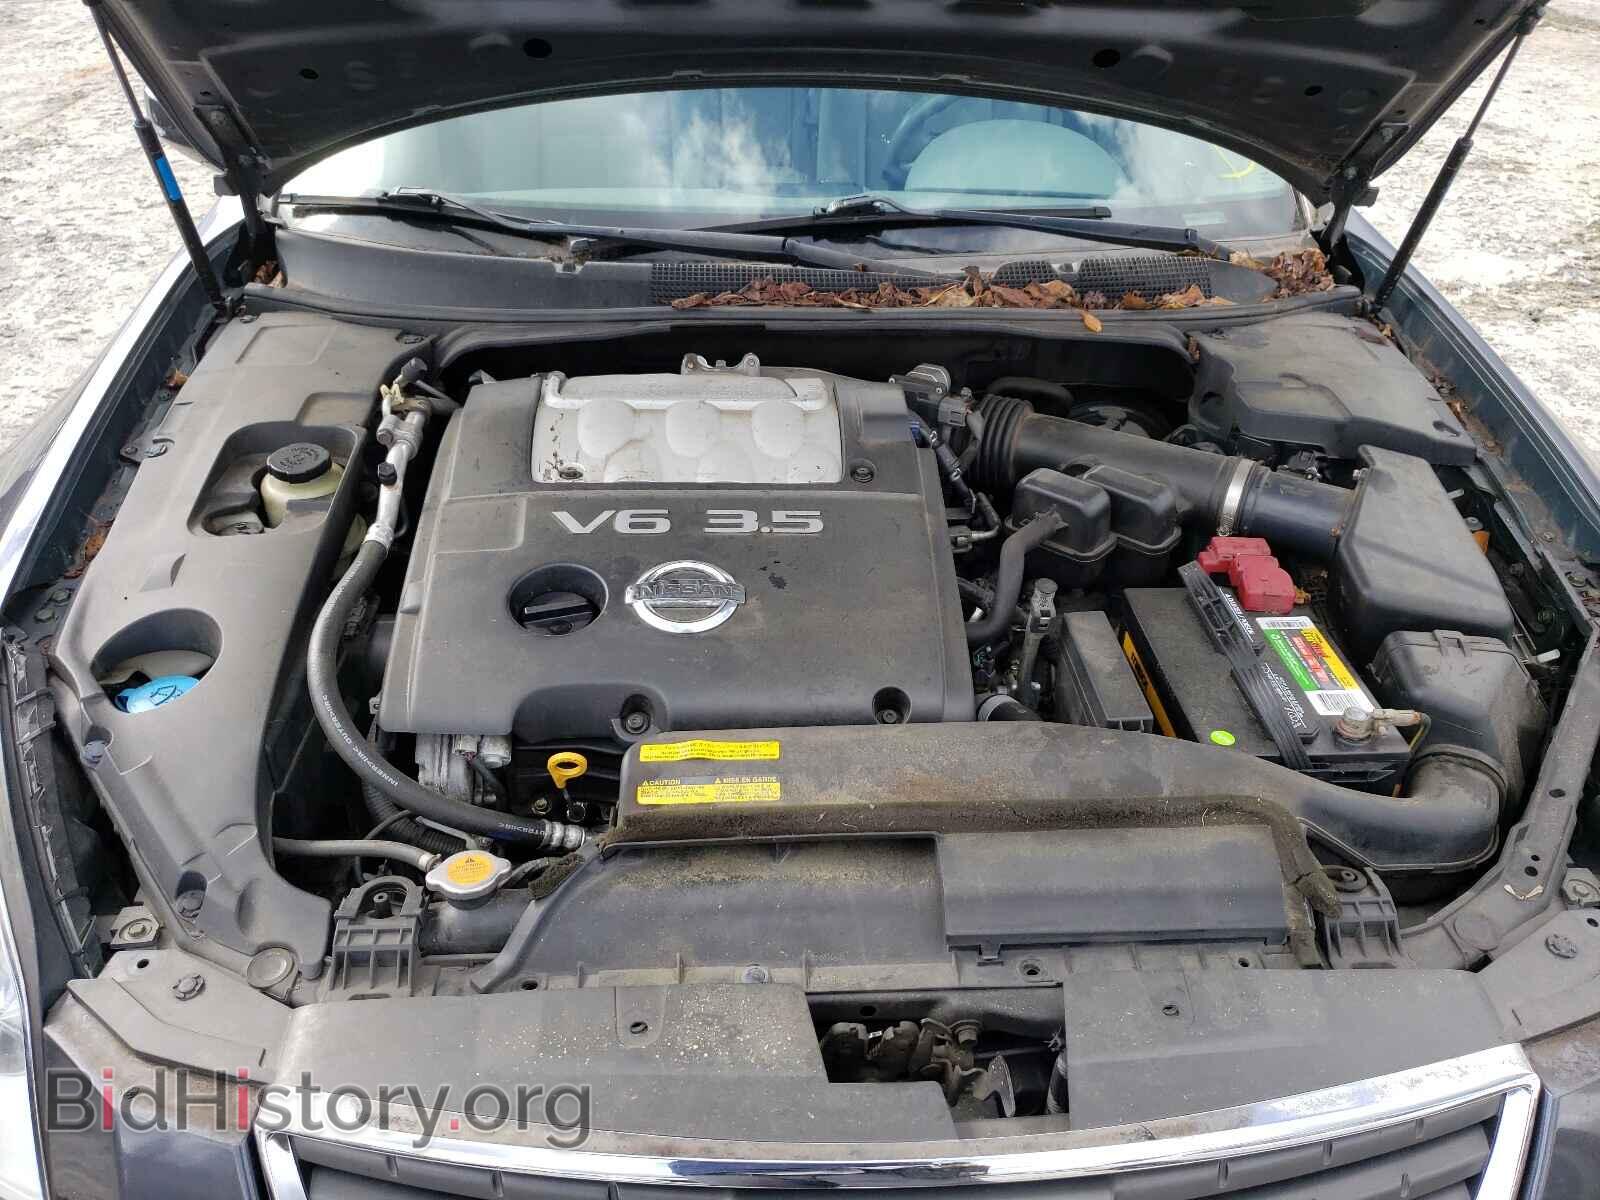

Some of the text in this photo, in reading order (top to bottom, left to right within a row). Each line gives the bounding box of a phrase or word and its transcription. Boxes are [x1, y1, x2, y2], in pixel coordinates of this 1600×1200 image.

[552, 509, 824, 534] V6 3.5
[640, 582, 735, 599] NISSAN
